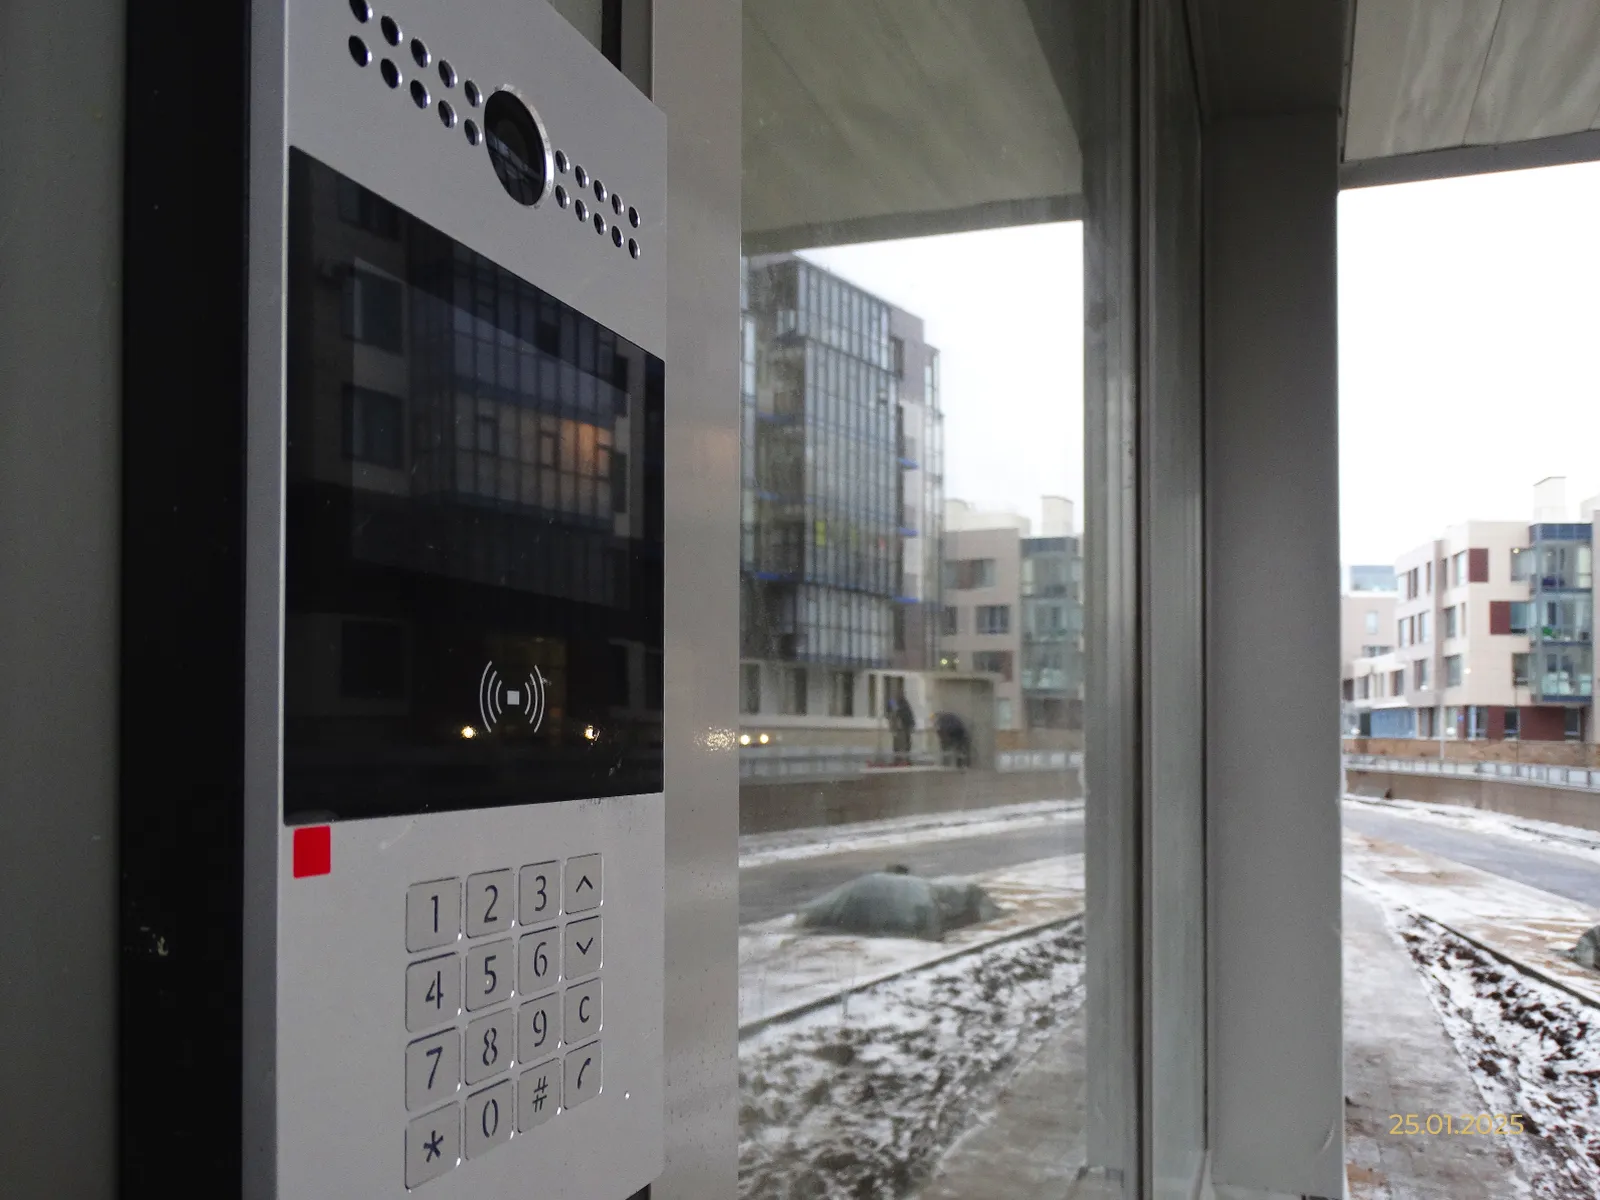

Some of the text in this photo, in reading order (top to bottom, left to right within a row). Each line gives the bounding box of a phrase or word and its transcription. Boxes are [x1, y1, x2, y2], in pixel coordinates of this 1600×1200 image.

[431, 875, 547, 933] 1 2 3
[425, 941, 548, 1009] 4 5 6
[426, 995, 590, 1089] 7 8 9 C
[482, 1098, 499, 1138] 0
[532, 1075, 548, 1112] #
